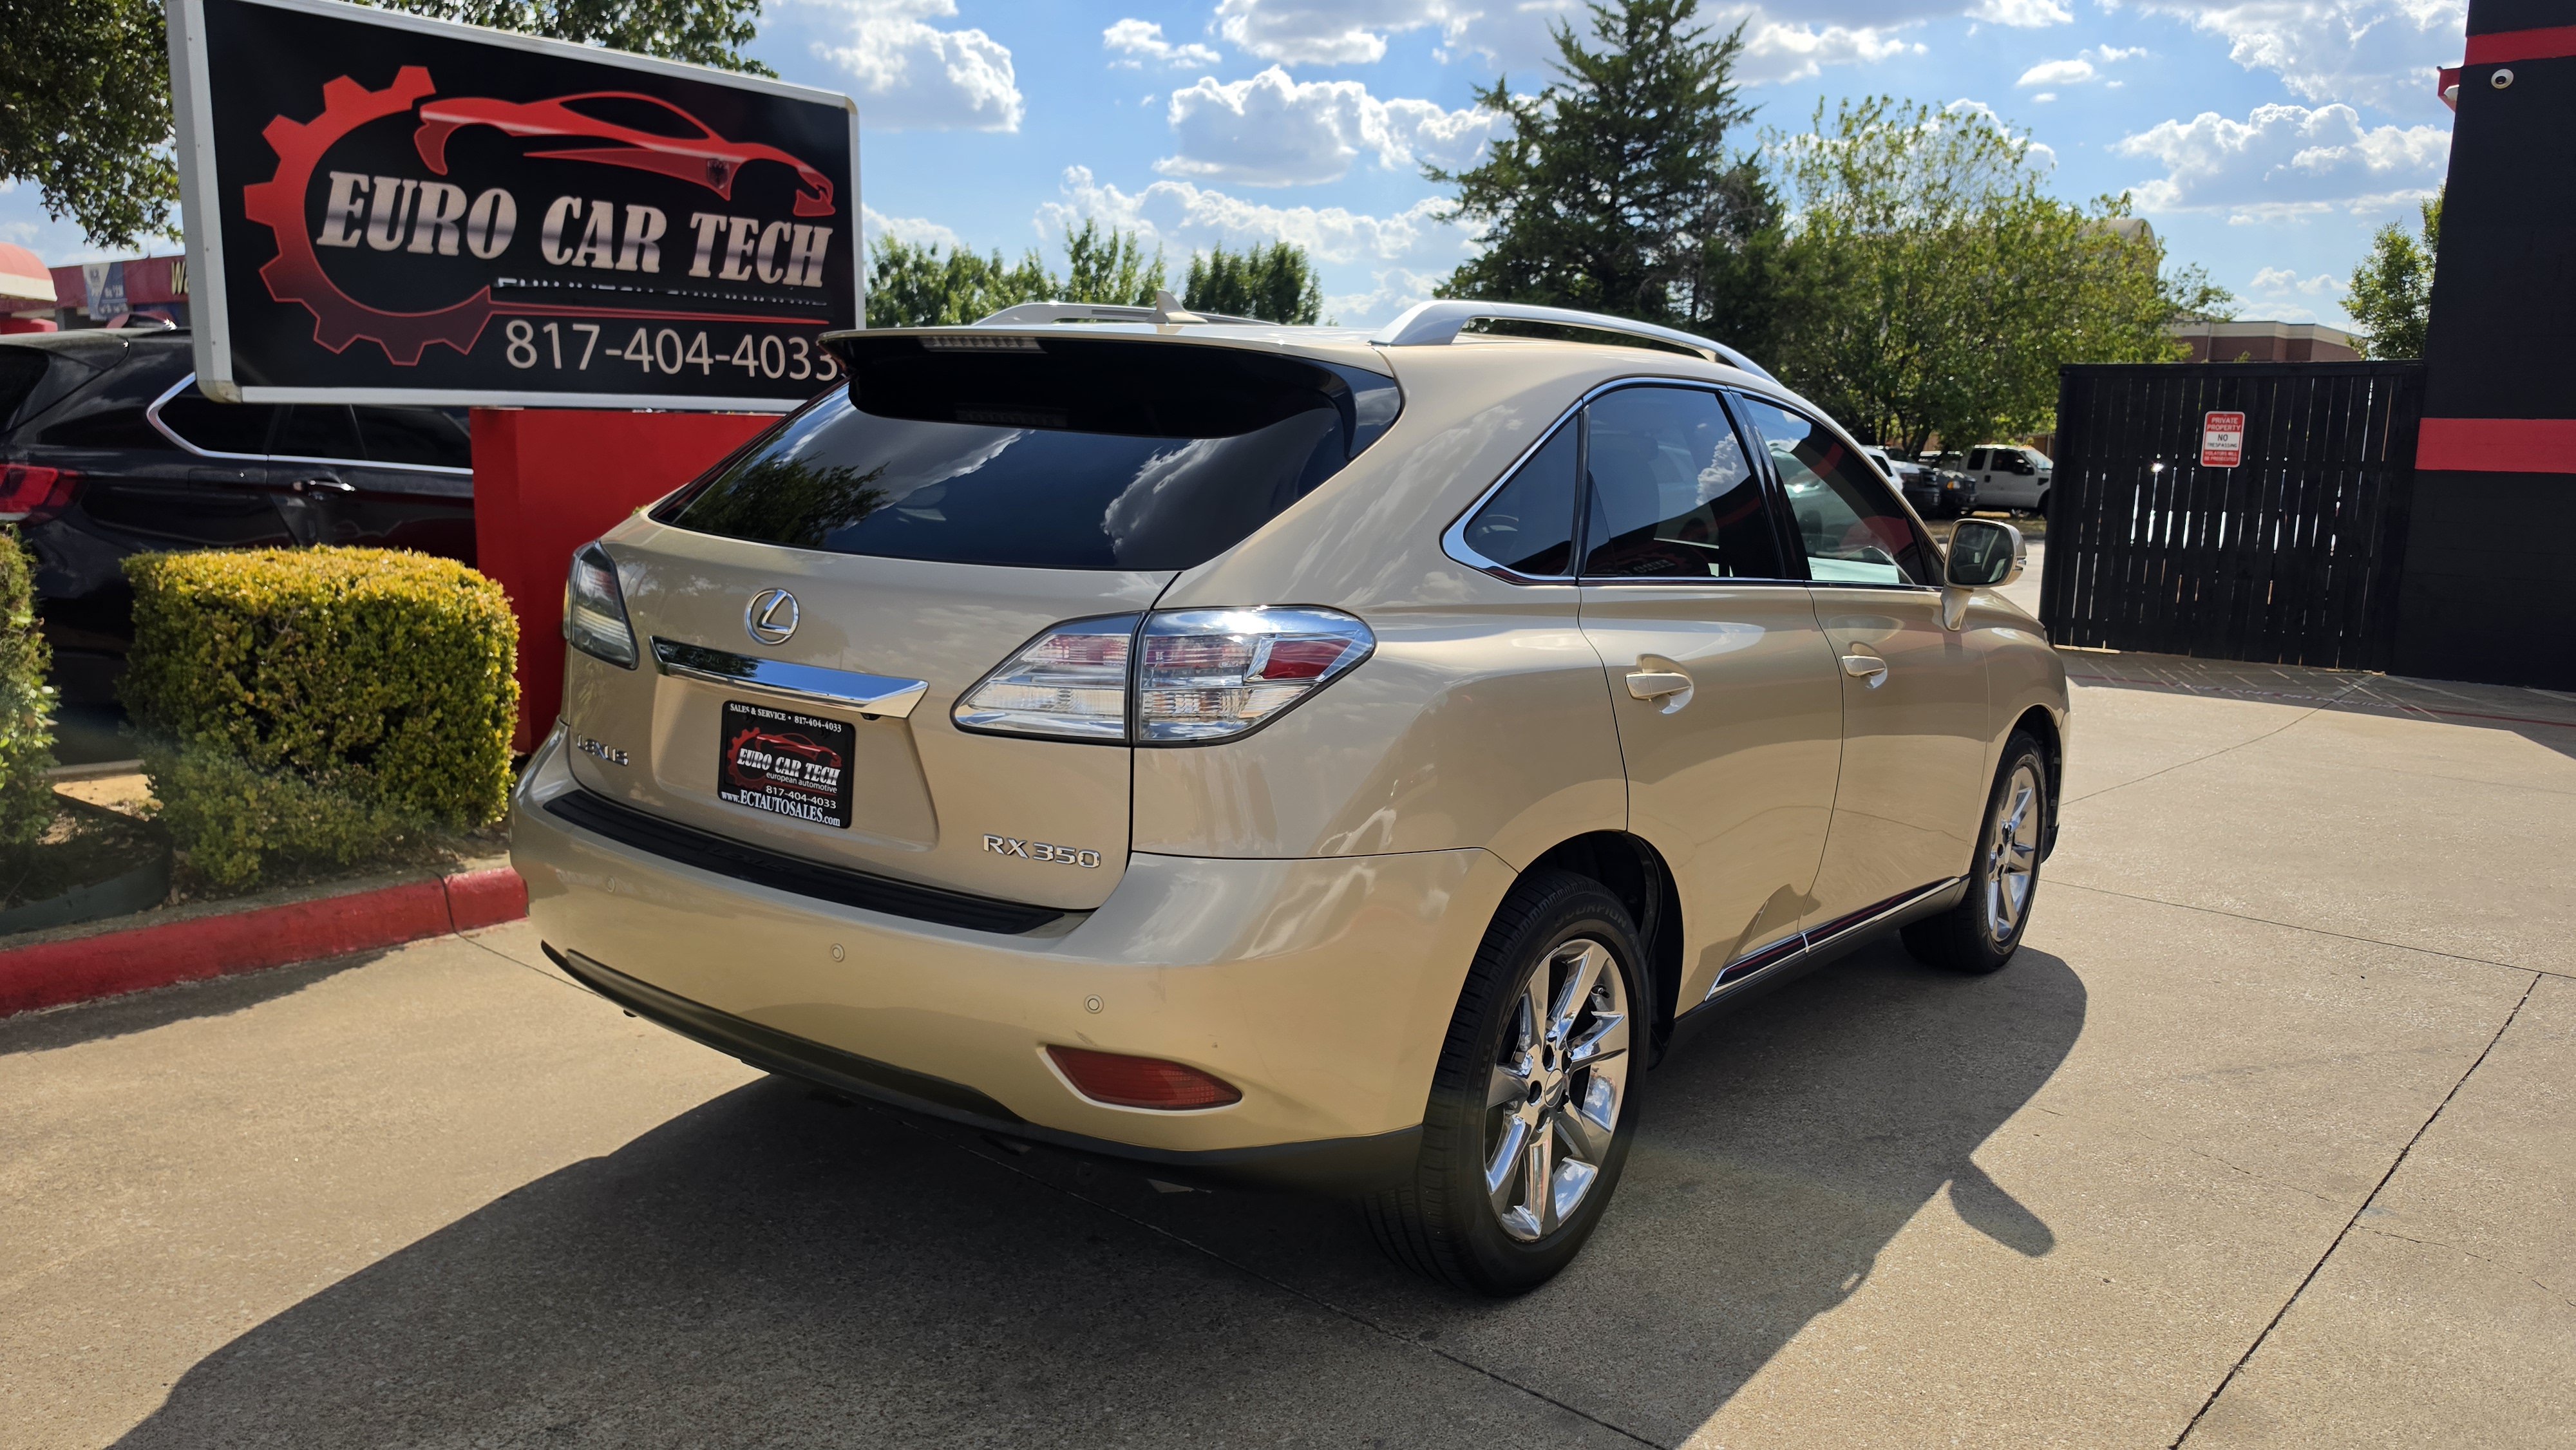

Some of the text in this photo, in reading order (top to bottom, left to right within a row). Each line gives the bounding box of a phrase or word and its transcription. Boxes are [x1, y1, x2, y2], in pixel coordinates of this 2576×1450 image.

[316, 171, 833, 288] EURO CAR TECH
[505, 319, 838, 382] 817-404-4033
[2217, 433, 2228, 442] NO
[730, 702, 842, 733] SALES & SERVICE 817-404-4033
[737, 748, 840, 786] EURO CAR TECH
[766, 772, 838, 794] european automotive
[721, 789, 840, 827] www.ECTAUTOSALES.com
[766, 785, 837, 809] 817-404-4033
